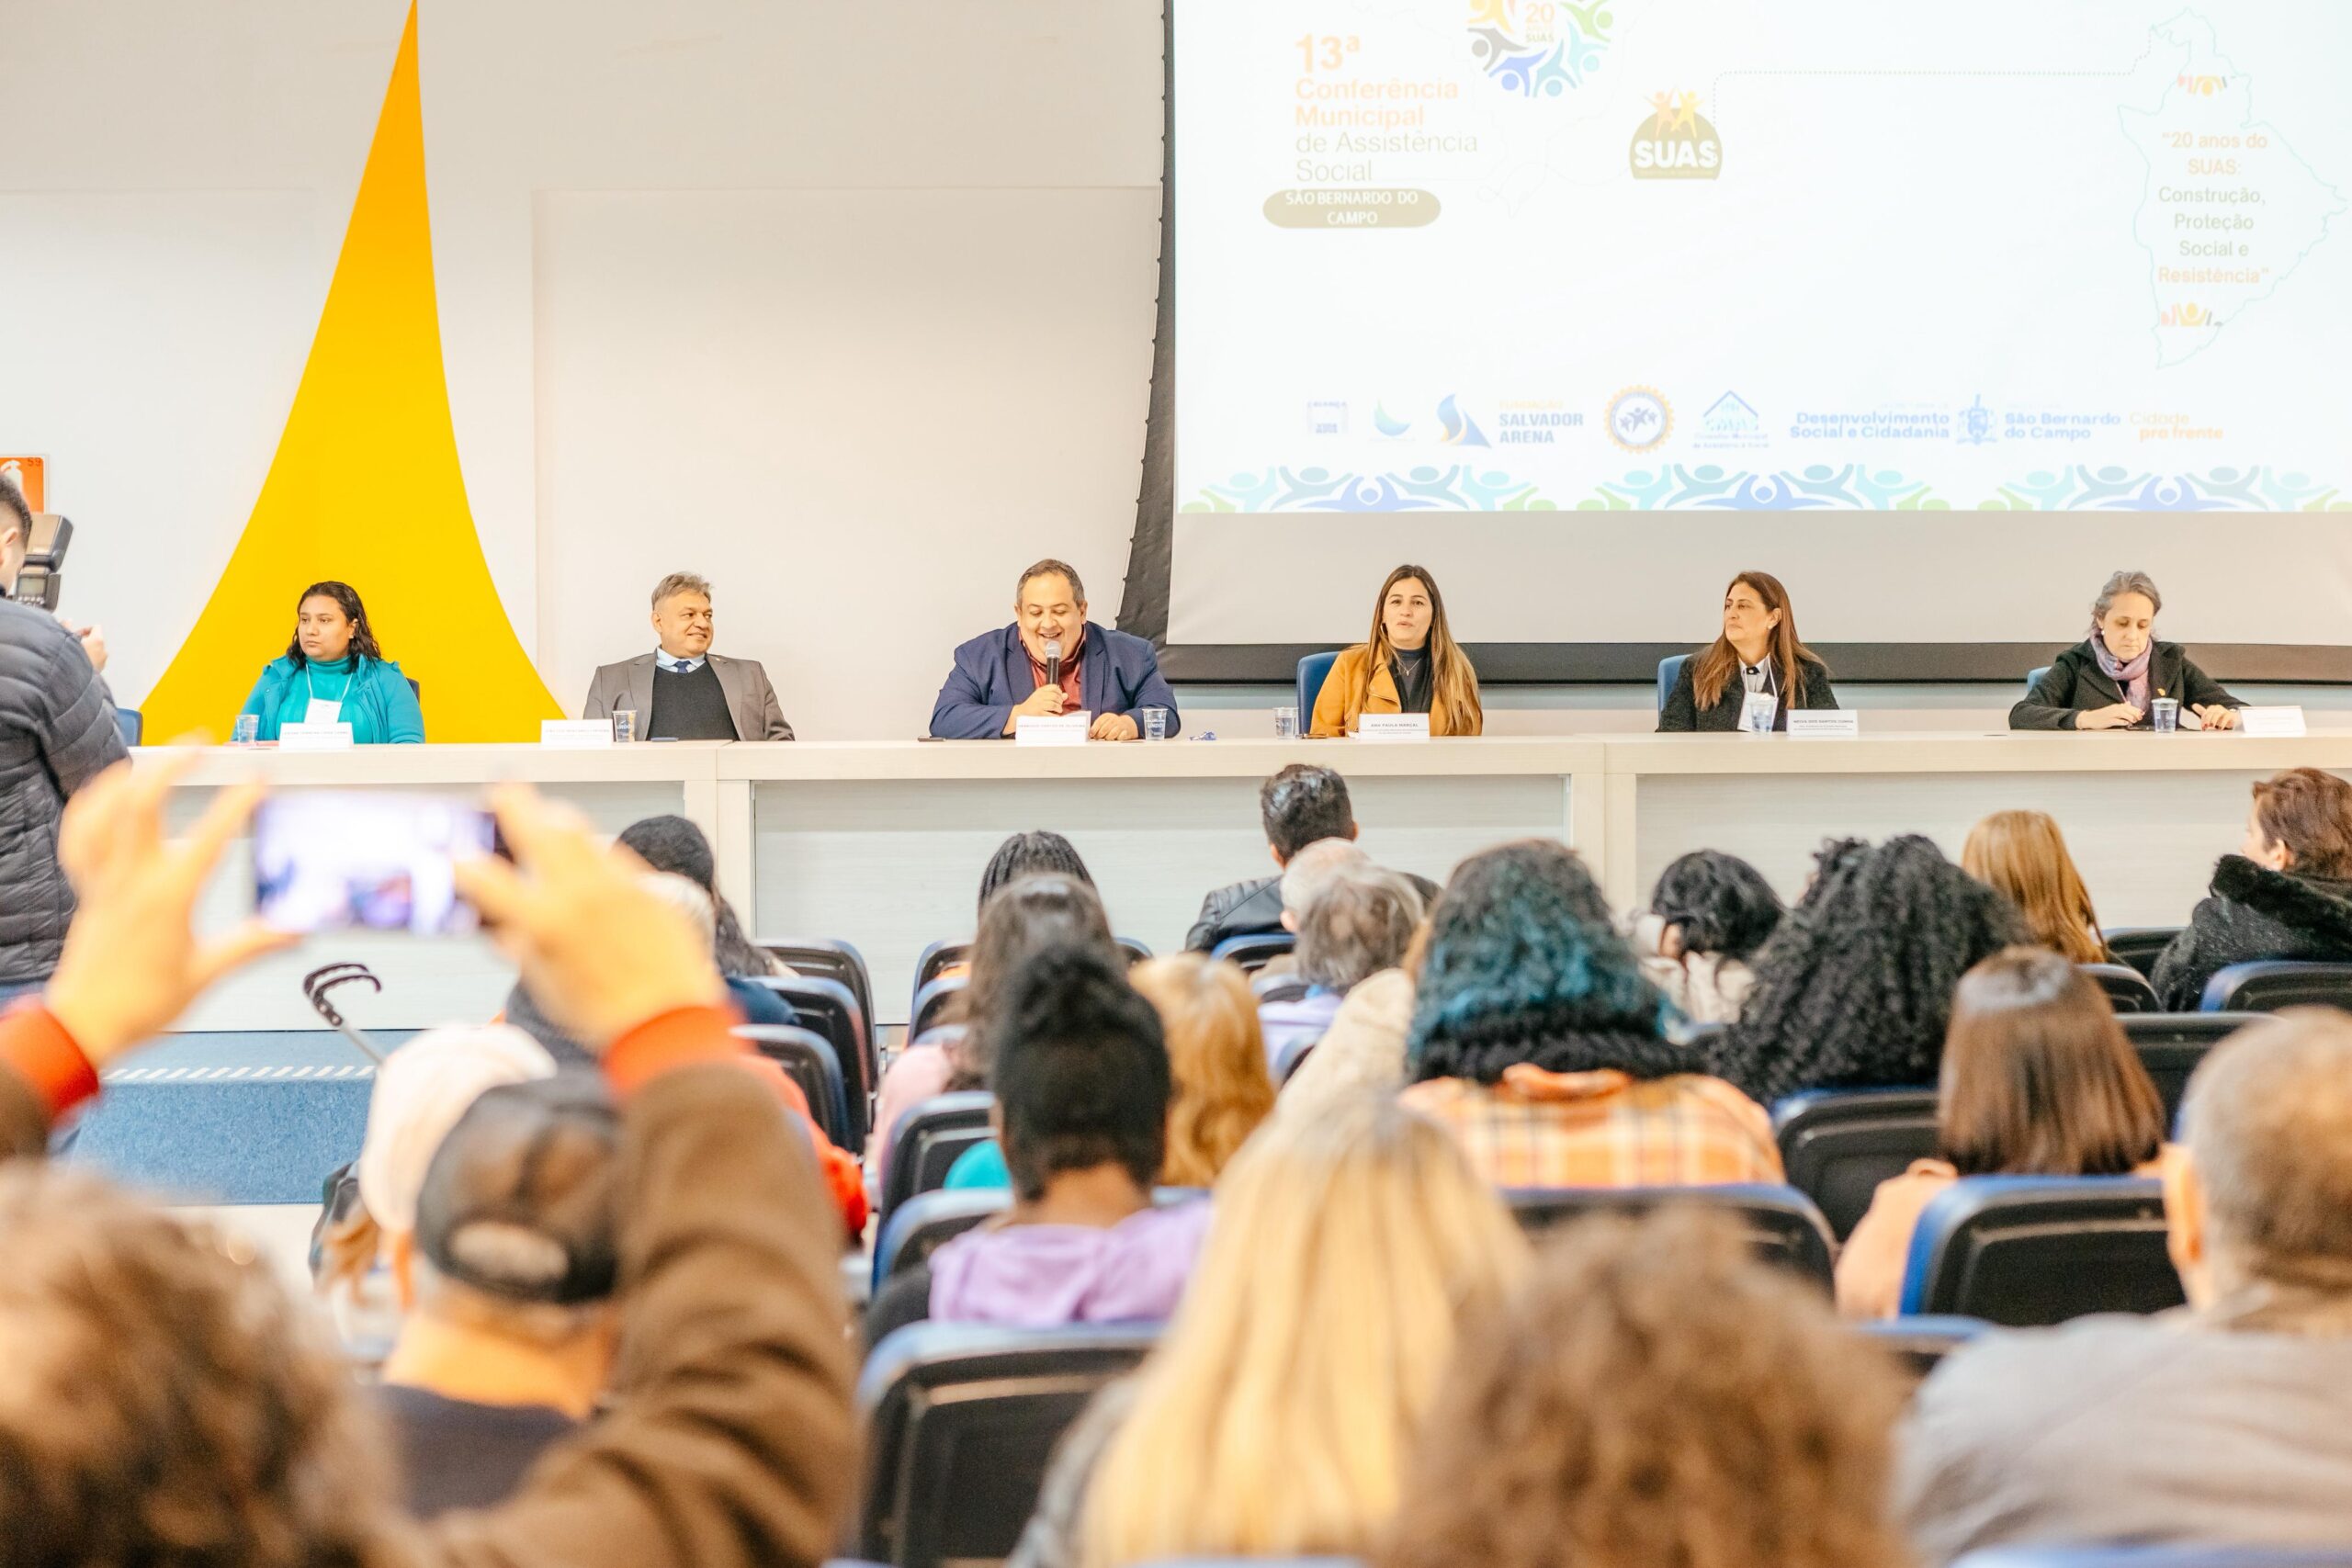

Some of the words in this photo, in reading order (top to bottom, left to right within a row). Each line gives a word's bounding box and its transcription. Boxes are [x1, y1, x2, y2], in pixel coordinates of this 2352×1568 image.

[1525, 3, 1555, 23] 20
[1295, 33, 1361, 73] 13ª
[1295, 76, 1459, 100] Conferência
[1295, 104, 1424, 132] Municipal
[1295, 131, 1328, 153] de
[1336, 130, 1478, 153] Assistência
[2198, 135, 2241, 148] anos
[2245, 132, 2268, 148] do
[1634, 140, 1719, 168] SUAS
[1295, 158, 1374, 183] Social
[2188, 157, 2242, 175] SUAS:
[1285, 188, 1315, 205] SÃO
[1317, 191, 1392, 205] BERNARDO
[1397, 191, 1419, 205] DO
[2158, 186, 2267, 207] Construção,
[1327, 211, 1378, 225] CAMPO
[2174, 212, 2255, 233] Proteção
[2178, 240, 2233, 257] Social
[2238, 243, 2250, 257] e
[1498, 412, 1584, 427] SALVADOR
[1795, 411, 1951, 424] Desenvolvimento
[2005, 412, 2037, 424] São
[2041, 412, 2121, 425] Bernardo
[2129, 411, 2190, 425] Cidade
[1498, 429, 1555, 444] ARENA
[1790, 424, 1844, 439] Social
[1847, 427, 1857, 439] e
[1860, 424, 1951, 439] Cidadania
[2004, 425, 2026, 439] do
[2030, 426, 2092, 443] Campo
